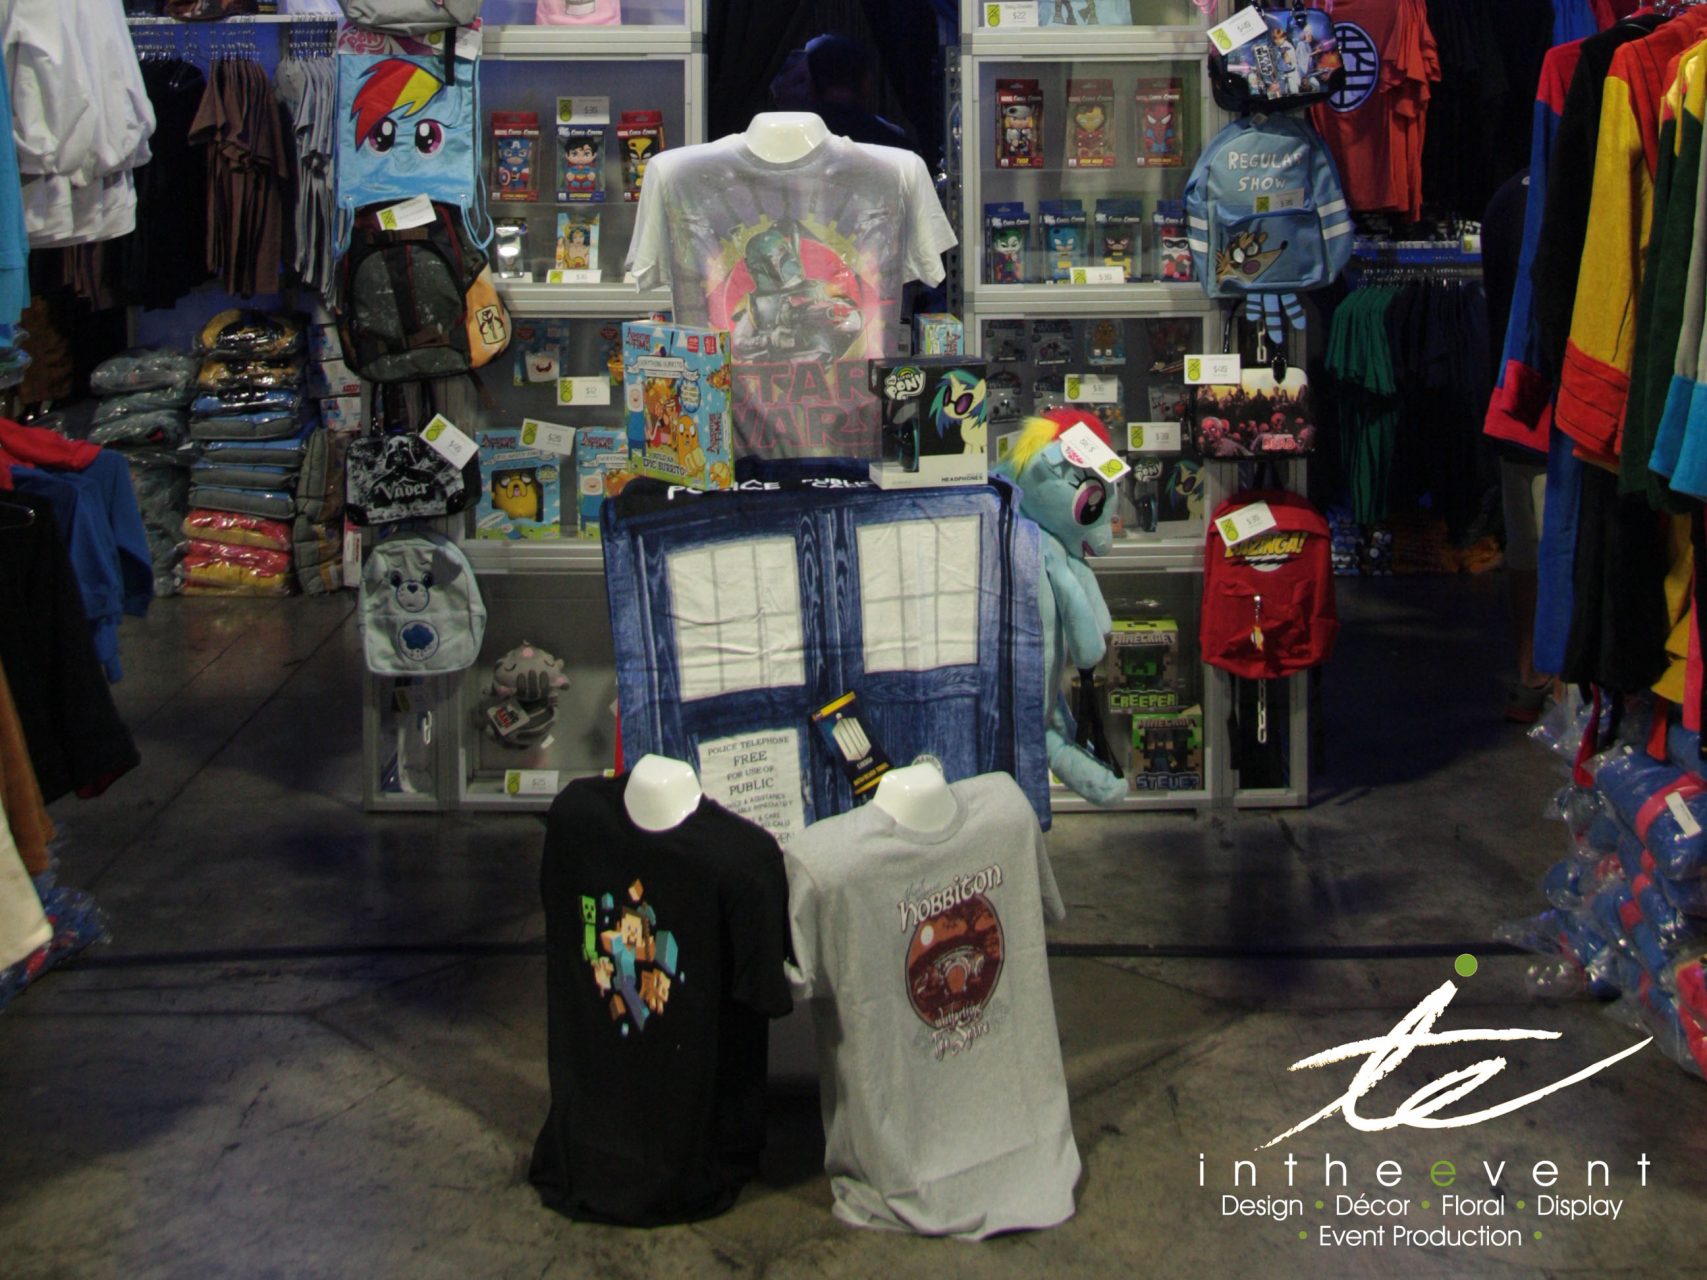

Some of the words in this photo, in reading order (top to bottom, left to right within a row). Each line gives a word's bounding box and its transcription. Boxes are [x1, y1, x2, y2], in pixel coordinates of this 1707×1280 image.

[1228, 151, 1303, 170] REGULAR
[1237, 176, 1286, 192] SHOW
[941, 475, 983, 483] HEADPHONES
[1111, 632, 1177, 647] MINECRAFT
[1110, 692, 1177, 708] CREEPER
[708, 742, 738, 756] POLICE
[740, 736, 790, 749] TELEPHONE
[733, 750, 768, 767] FREE
[726, 771, 743, 781] FOR
[745, 767, 761, 776] USE
[762, 765, 774, 773] OF
[729, 777, 774, 796] PUBLIC
